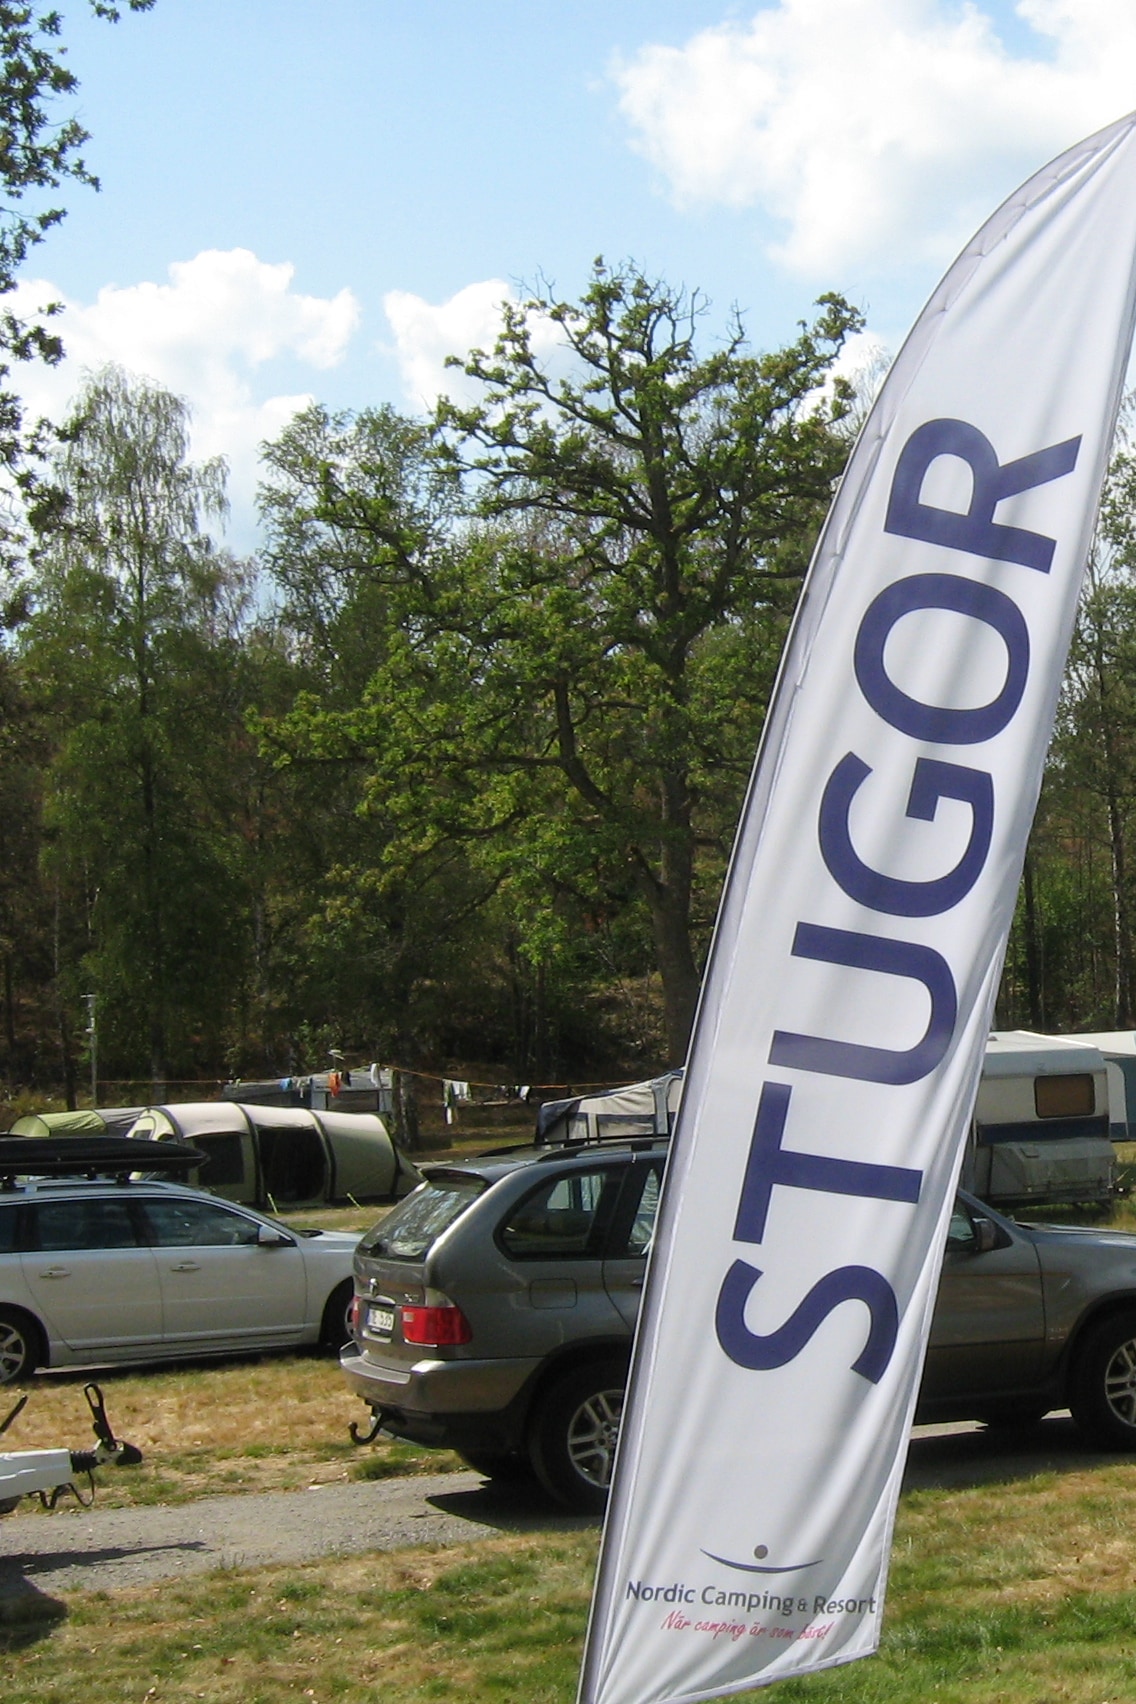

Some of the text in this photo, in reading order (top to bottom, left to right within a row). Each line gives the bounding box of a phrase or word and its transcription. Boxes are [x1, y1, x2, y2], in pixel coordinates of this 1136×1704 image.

[714, 417, 1083, 1384] STUGOR
[625, 1580, 877, 1617] Nordic Camping & Resort
[660, 1610, 692, 1630] När
[694, 1619, 747, 1641] camping
[749, 1622, 767, 1636] är
